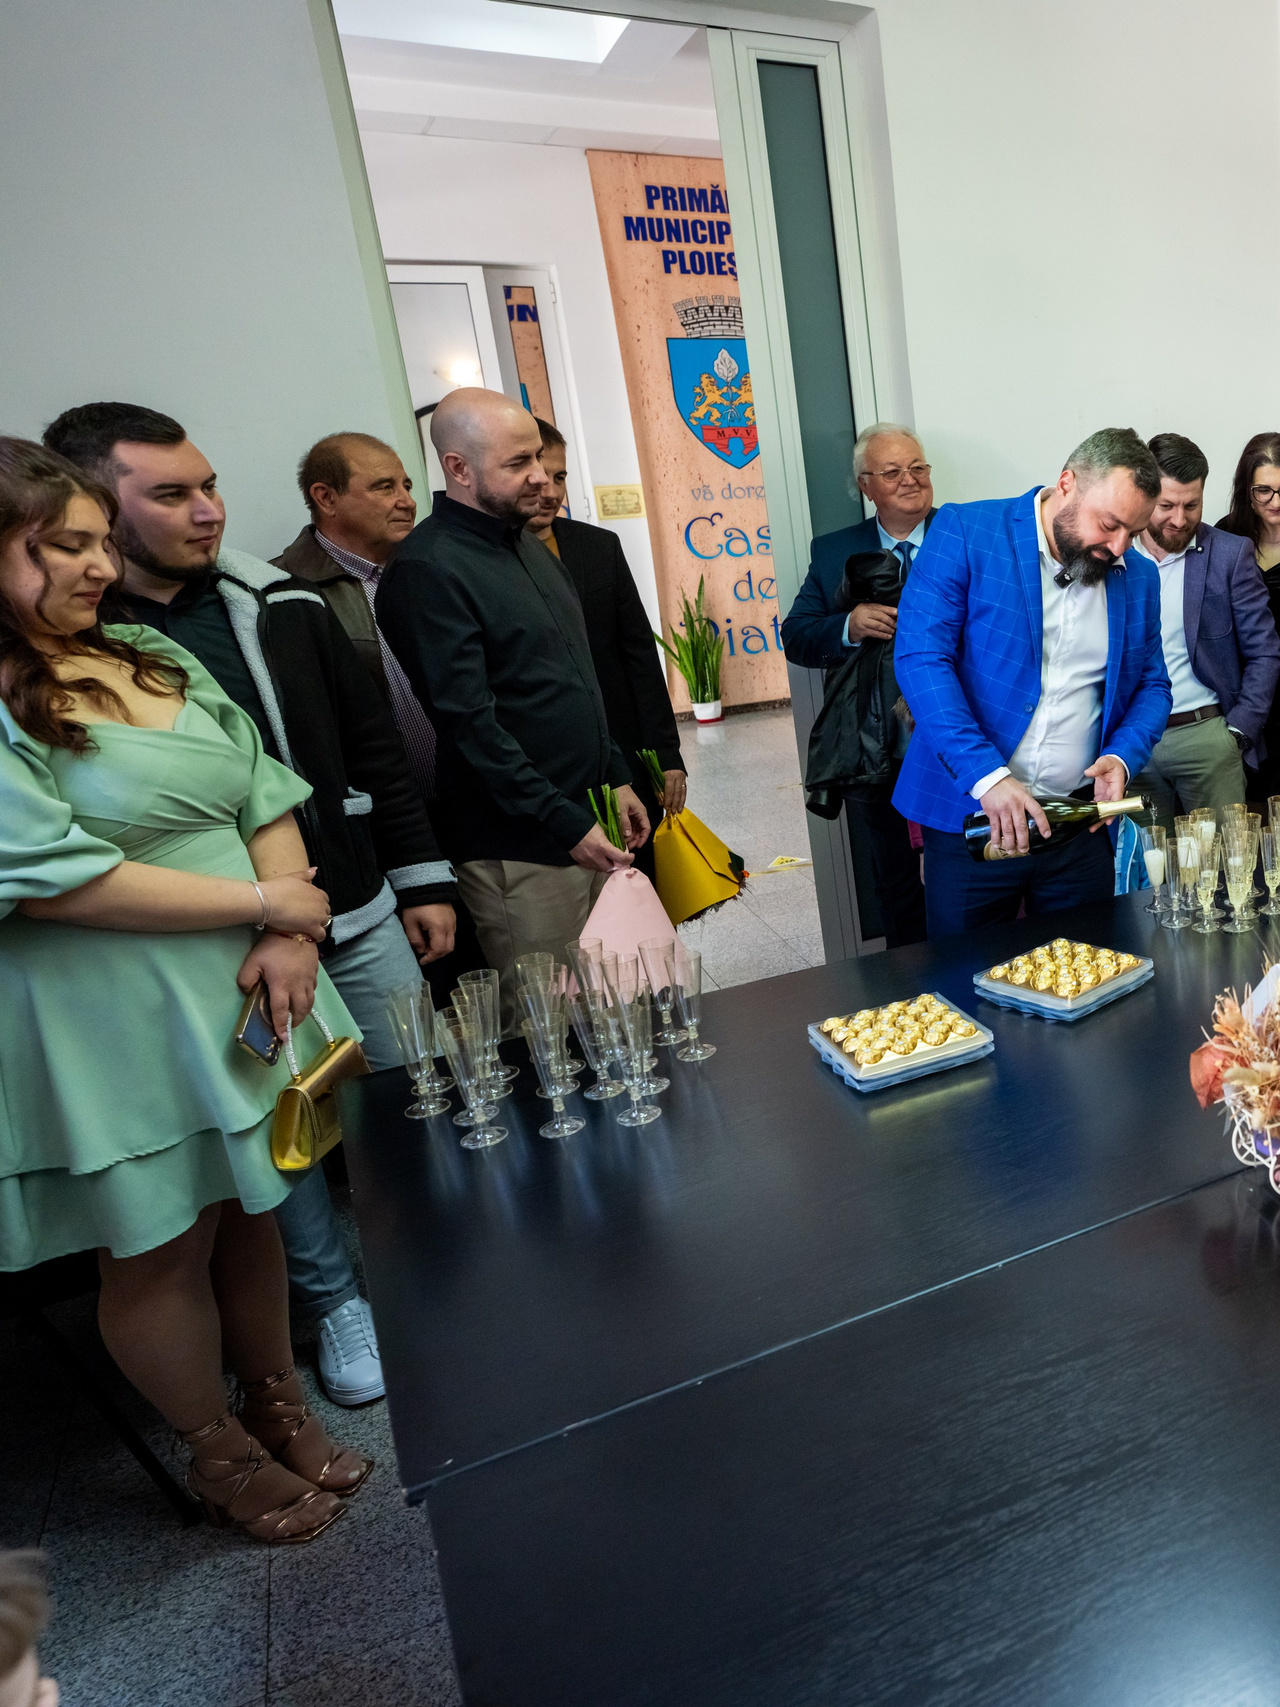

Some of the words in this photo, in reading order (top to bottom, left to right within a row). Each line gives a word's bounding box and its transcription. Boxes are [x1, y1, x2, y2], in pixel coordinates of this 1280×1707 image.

[644, 184, 730, 214] PRIMĂ
[623, 216, 731, 245] MUNICIP
[684, 512, 773, 560] Cas
[733, 570, 778, 604] de
